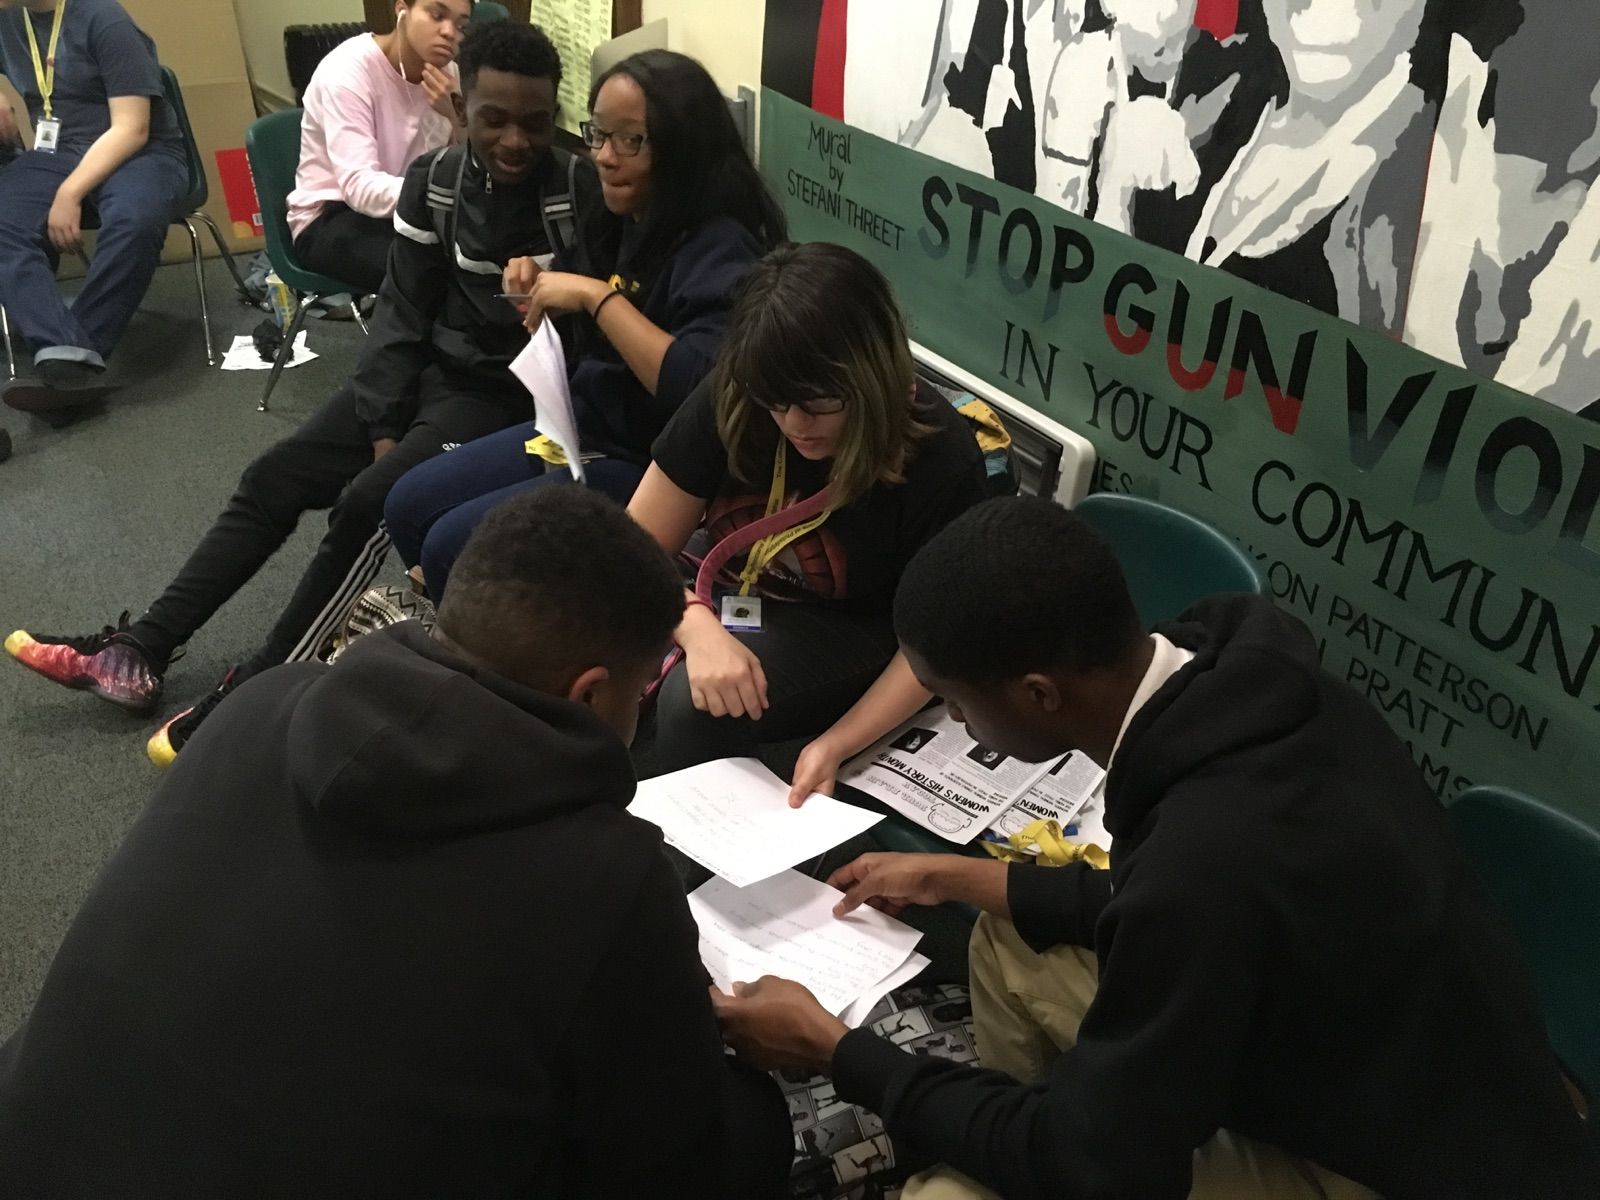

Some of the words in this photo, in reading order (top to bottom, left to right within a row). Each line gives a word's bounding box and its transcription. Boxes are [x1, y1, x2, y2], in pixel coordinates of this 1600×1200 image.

[807, 120, 852, 165] Mural
[828, 161, 845, 187] by
[786, 168, 842, 218] STEFANI
[845, 198, 905, 251] THREET
[917, 175, 1095, 323] STOP
[1103, 262, 1319, 436] GUN
[999, 320, 1061, 402] IN
[1083, 362, 1214, 491] YOUR
[1252, 460, 1600, 712] COMMUN
[1328, 595, 1549, 751] PATTERSON
[1346, 656, 1464, 749] PRATT
[905, 768, 944, 793] HISTORY
[948, 789, 990, 813] WOMEN'S
